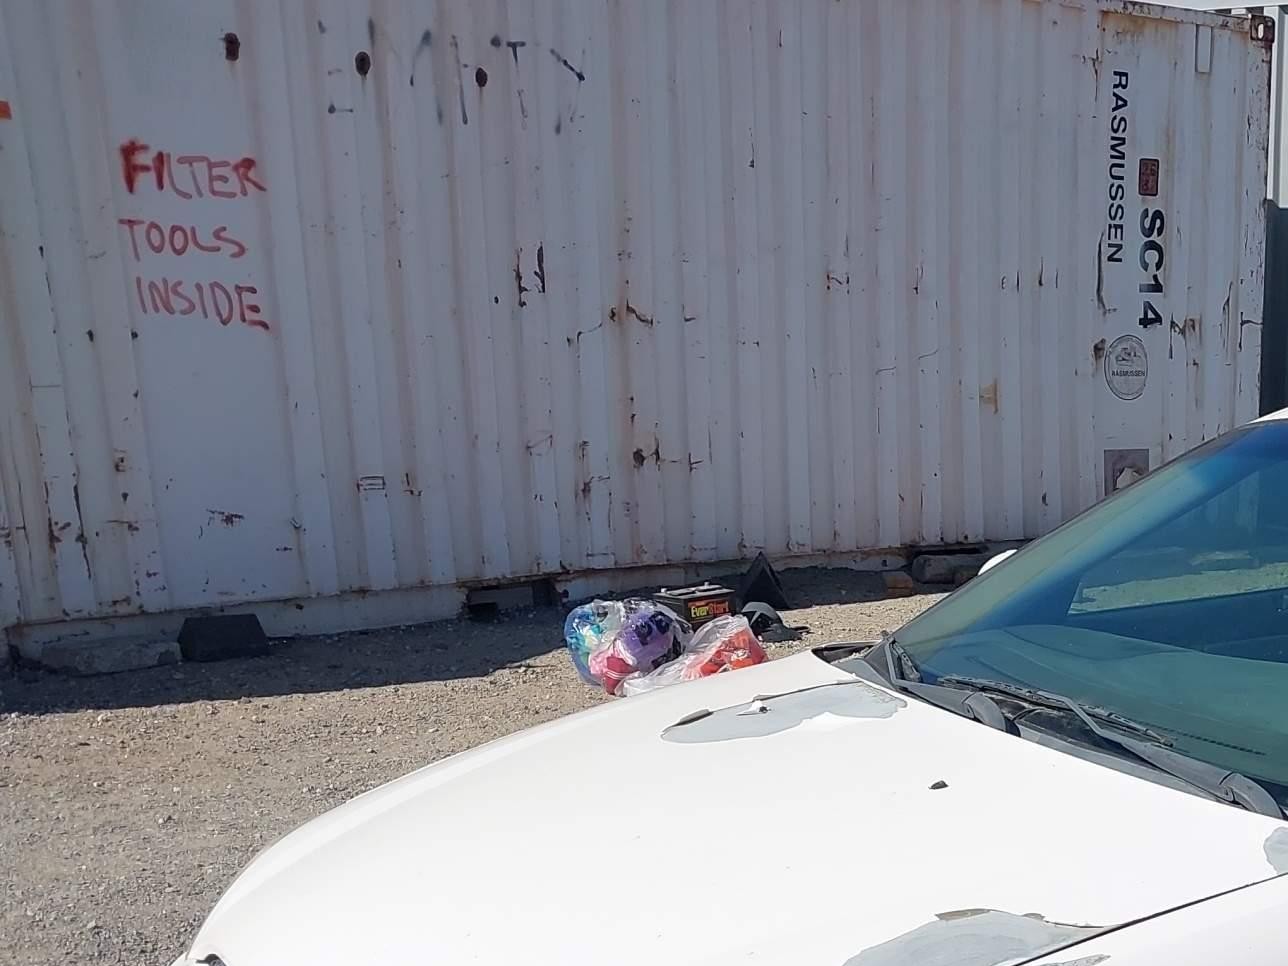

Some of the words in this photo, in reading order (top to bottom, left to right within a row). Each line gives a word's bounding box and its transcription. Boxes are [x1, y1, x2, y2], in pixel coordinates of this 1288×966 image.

[119, 139, 267, 199] FILTER
[1106, 70, 1130, 263] RASMUSSEN
[117, 218, 248, 262] TOOLS
[1138, 207, 1166, 329] SC14
[135, 276, 270, 331] INSIDE
